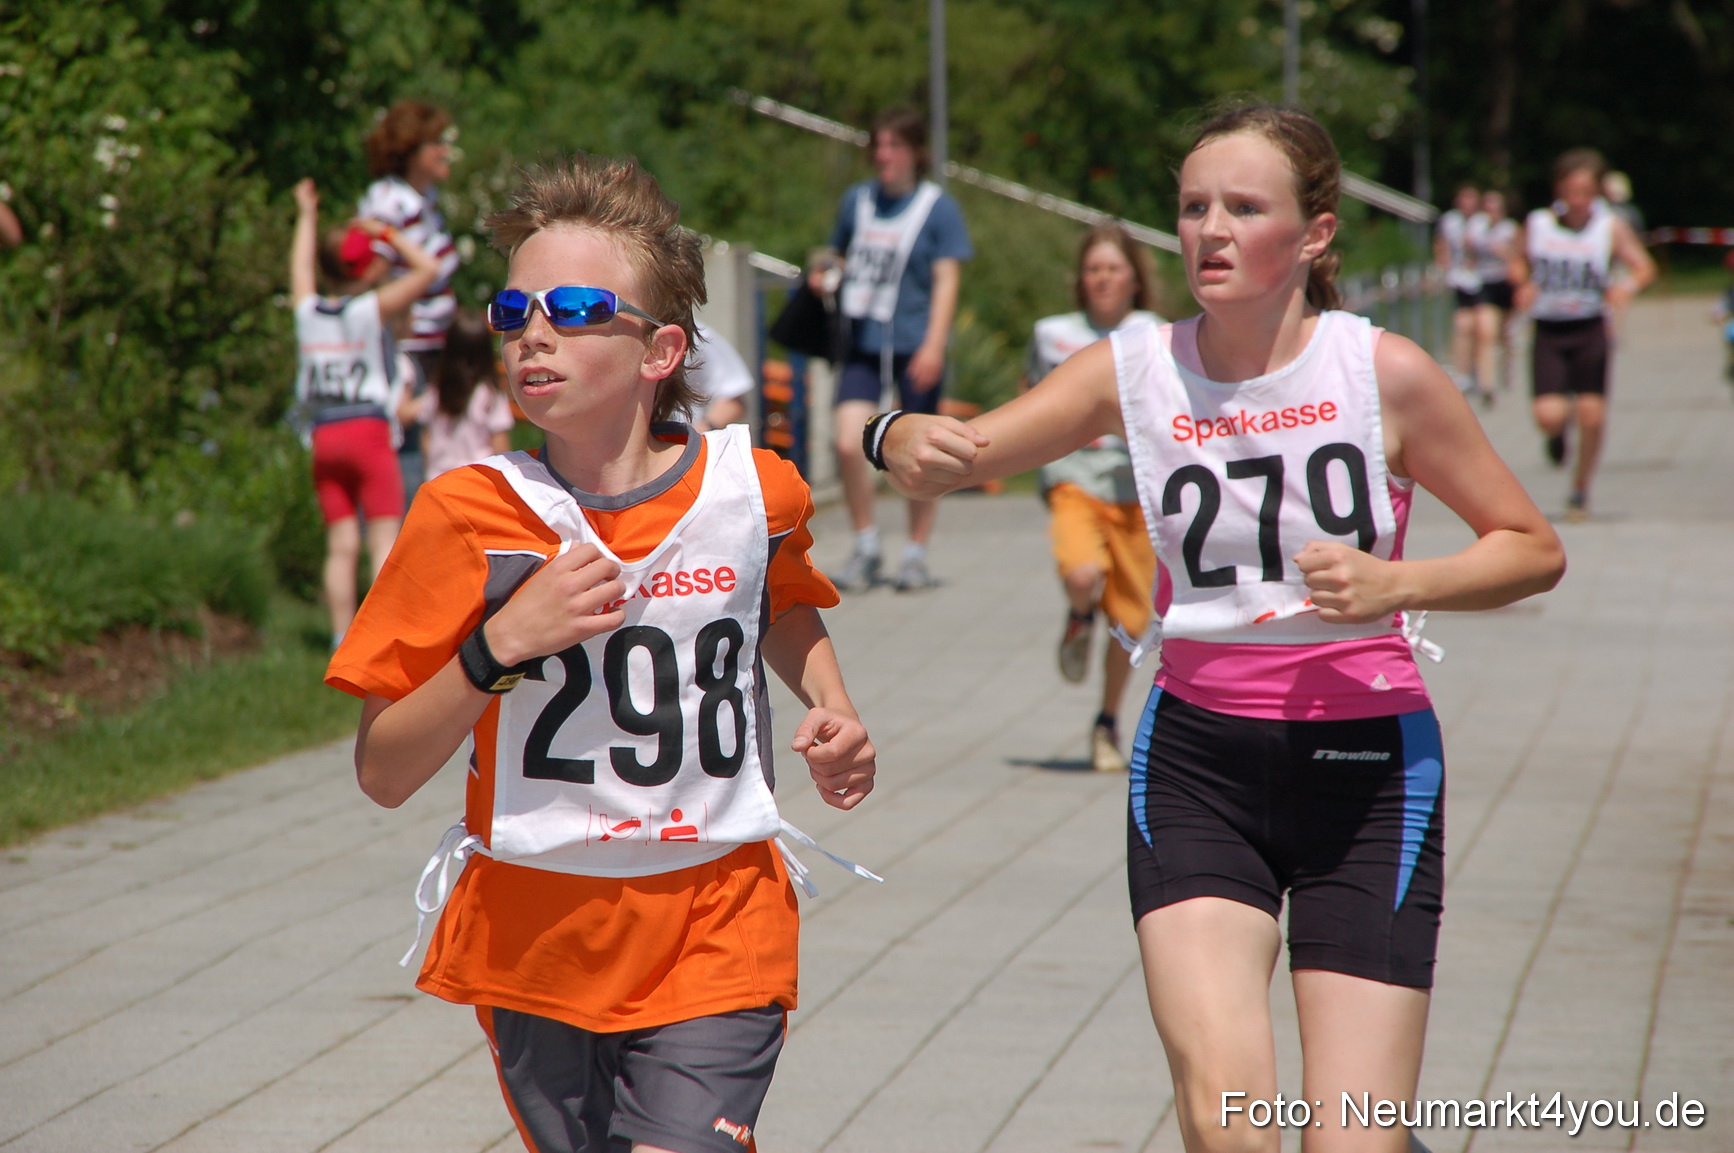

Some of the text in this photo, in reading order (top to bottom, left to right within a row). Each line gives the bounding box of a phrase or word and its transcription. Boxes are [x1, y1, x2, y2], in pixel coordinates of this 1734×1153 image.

[1172, 401, 1338, 446] Sparkasse
[1162, 442, 1378, 588] 279
[520, 617, 745, 786] 298
